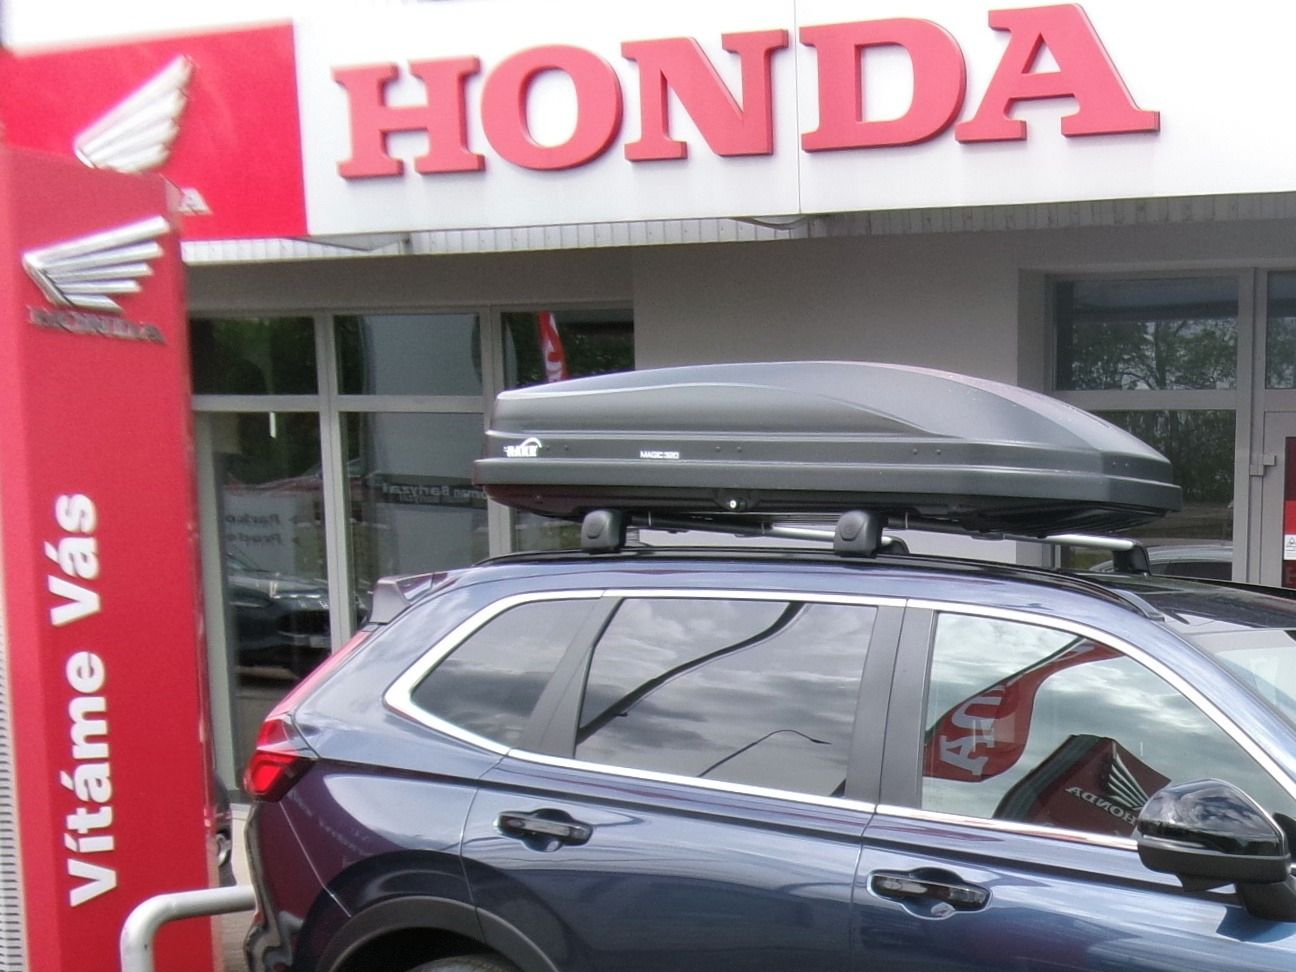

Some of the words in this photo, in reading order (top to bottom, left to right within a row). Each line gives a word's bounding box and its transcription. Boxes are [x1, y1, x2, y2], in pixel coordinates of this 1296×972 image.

[330, 3, 1161, 180] HONDA
[46, 491, 102, 627] Vás
[54, 649, 118, 908] Vítáme
